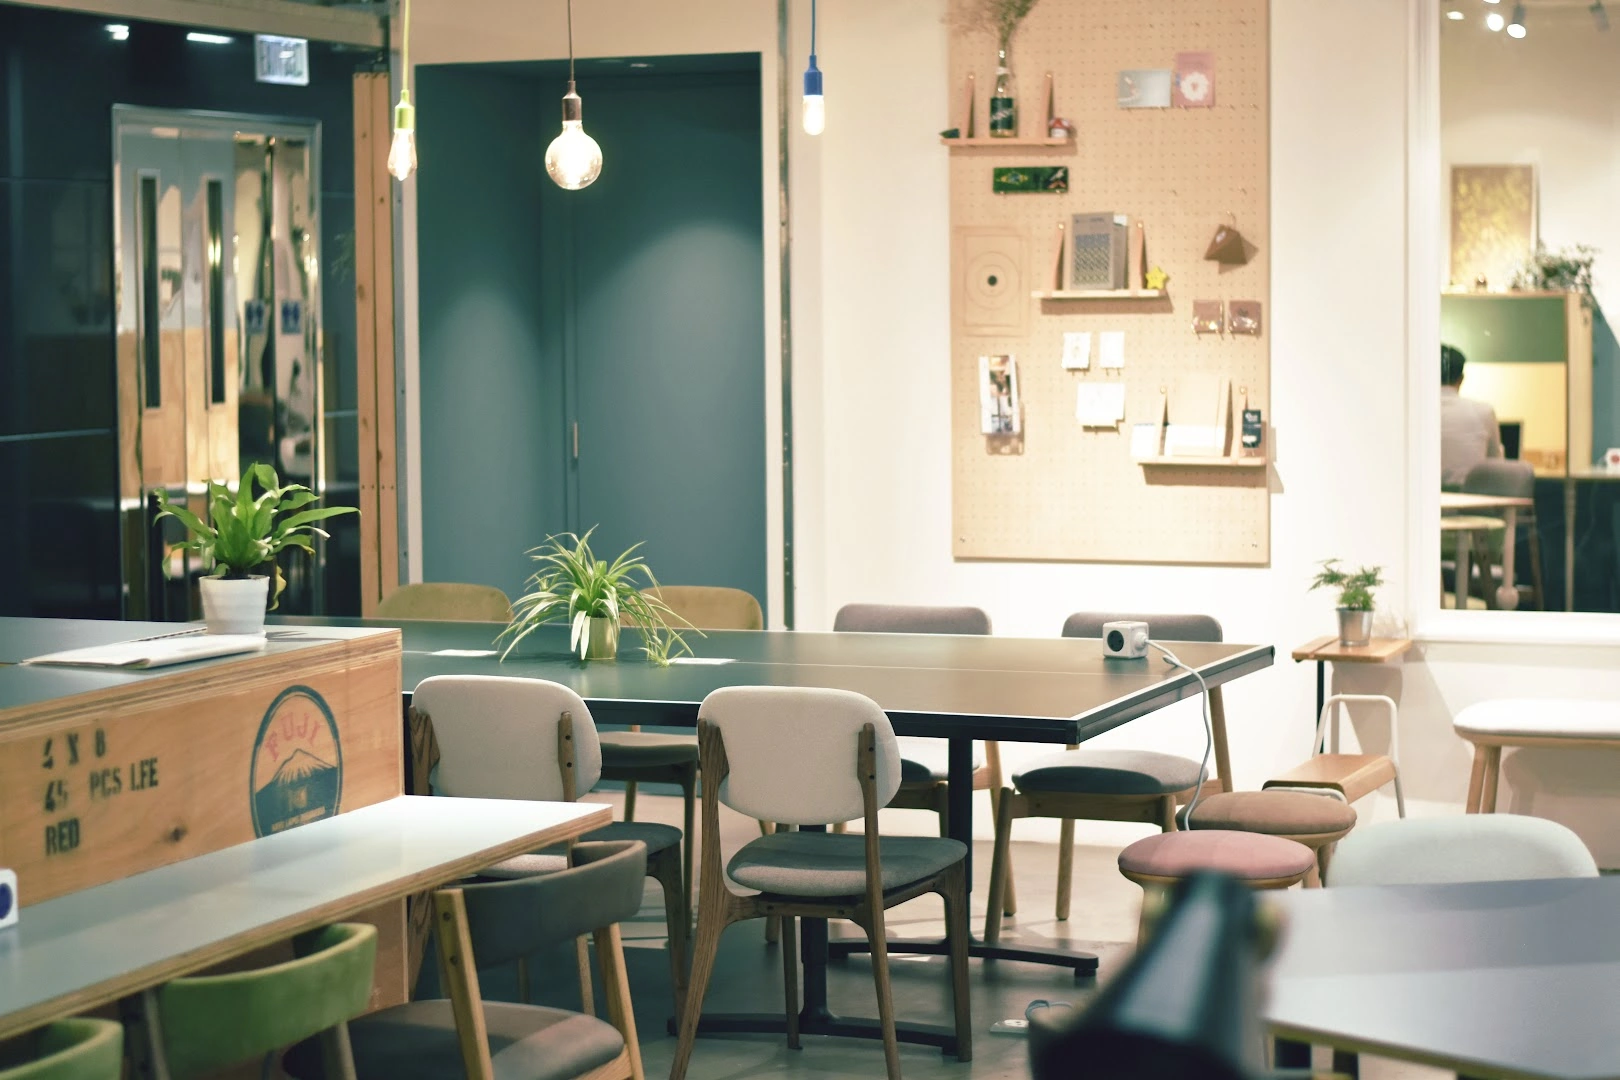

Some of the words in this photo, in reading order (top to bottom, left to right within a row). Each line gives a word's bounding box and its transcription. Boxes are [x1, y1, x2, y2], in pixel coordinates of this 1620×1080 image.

[264, 710, 320, 762] FUJI
[89, 766, 122, 800] PCS
[44, 816, 81, 857] RED
